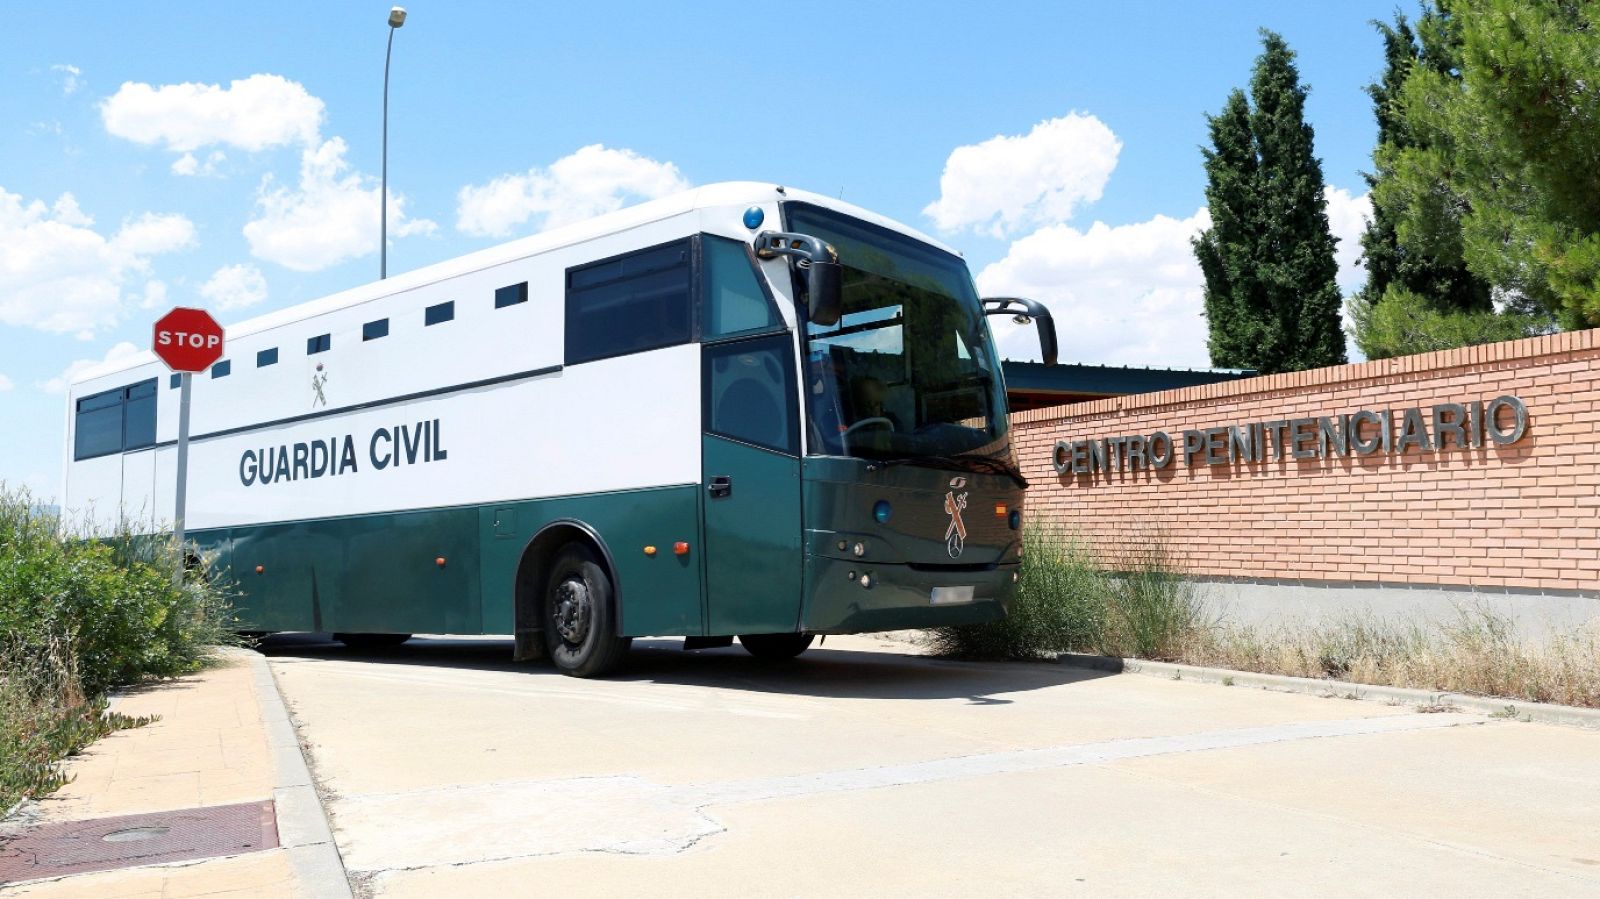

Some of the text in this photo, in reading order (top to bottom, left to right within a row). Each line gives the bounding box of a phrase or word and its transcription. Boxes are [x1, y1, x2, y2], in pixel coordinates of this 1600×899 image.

[158, 331, 220, 349] STOP
[239, 418, 448, 487] GUARDIA CIVIL
[1052, 395, 1529, 475] CENTRO PENITENCIARIO
